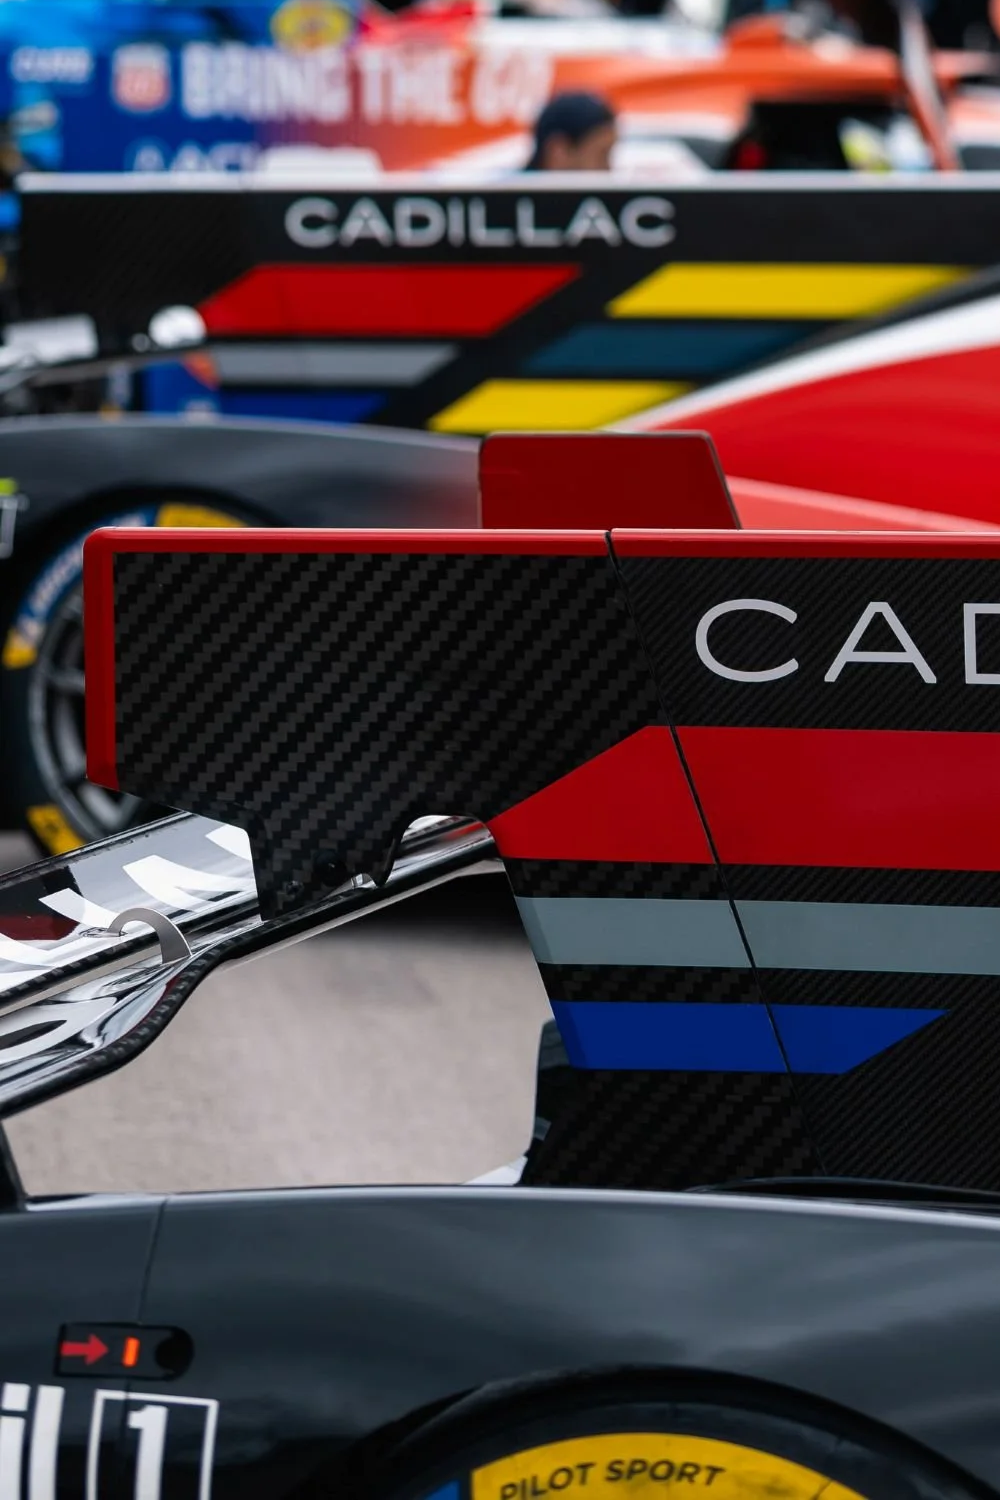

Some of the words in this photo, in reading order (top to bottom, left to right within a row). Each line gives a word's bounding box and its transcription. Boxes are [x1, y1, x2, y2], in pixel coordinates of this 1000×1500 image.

[180, 44, 349, 123] BRING
[356, 49, 464, 125] THE
[284, 197, 677, 248] CADILLAC
[500, 1462, 596, 1500] PILOT
[604, 1459, 726, 1487] SPORT
